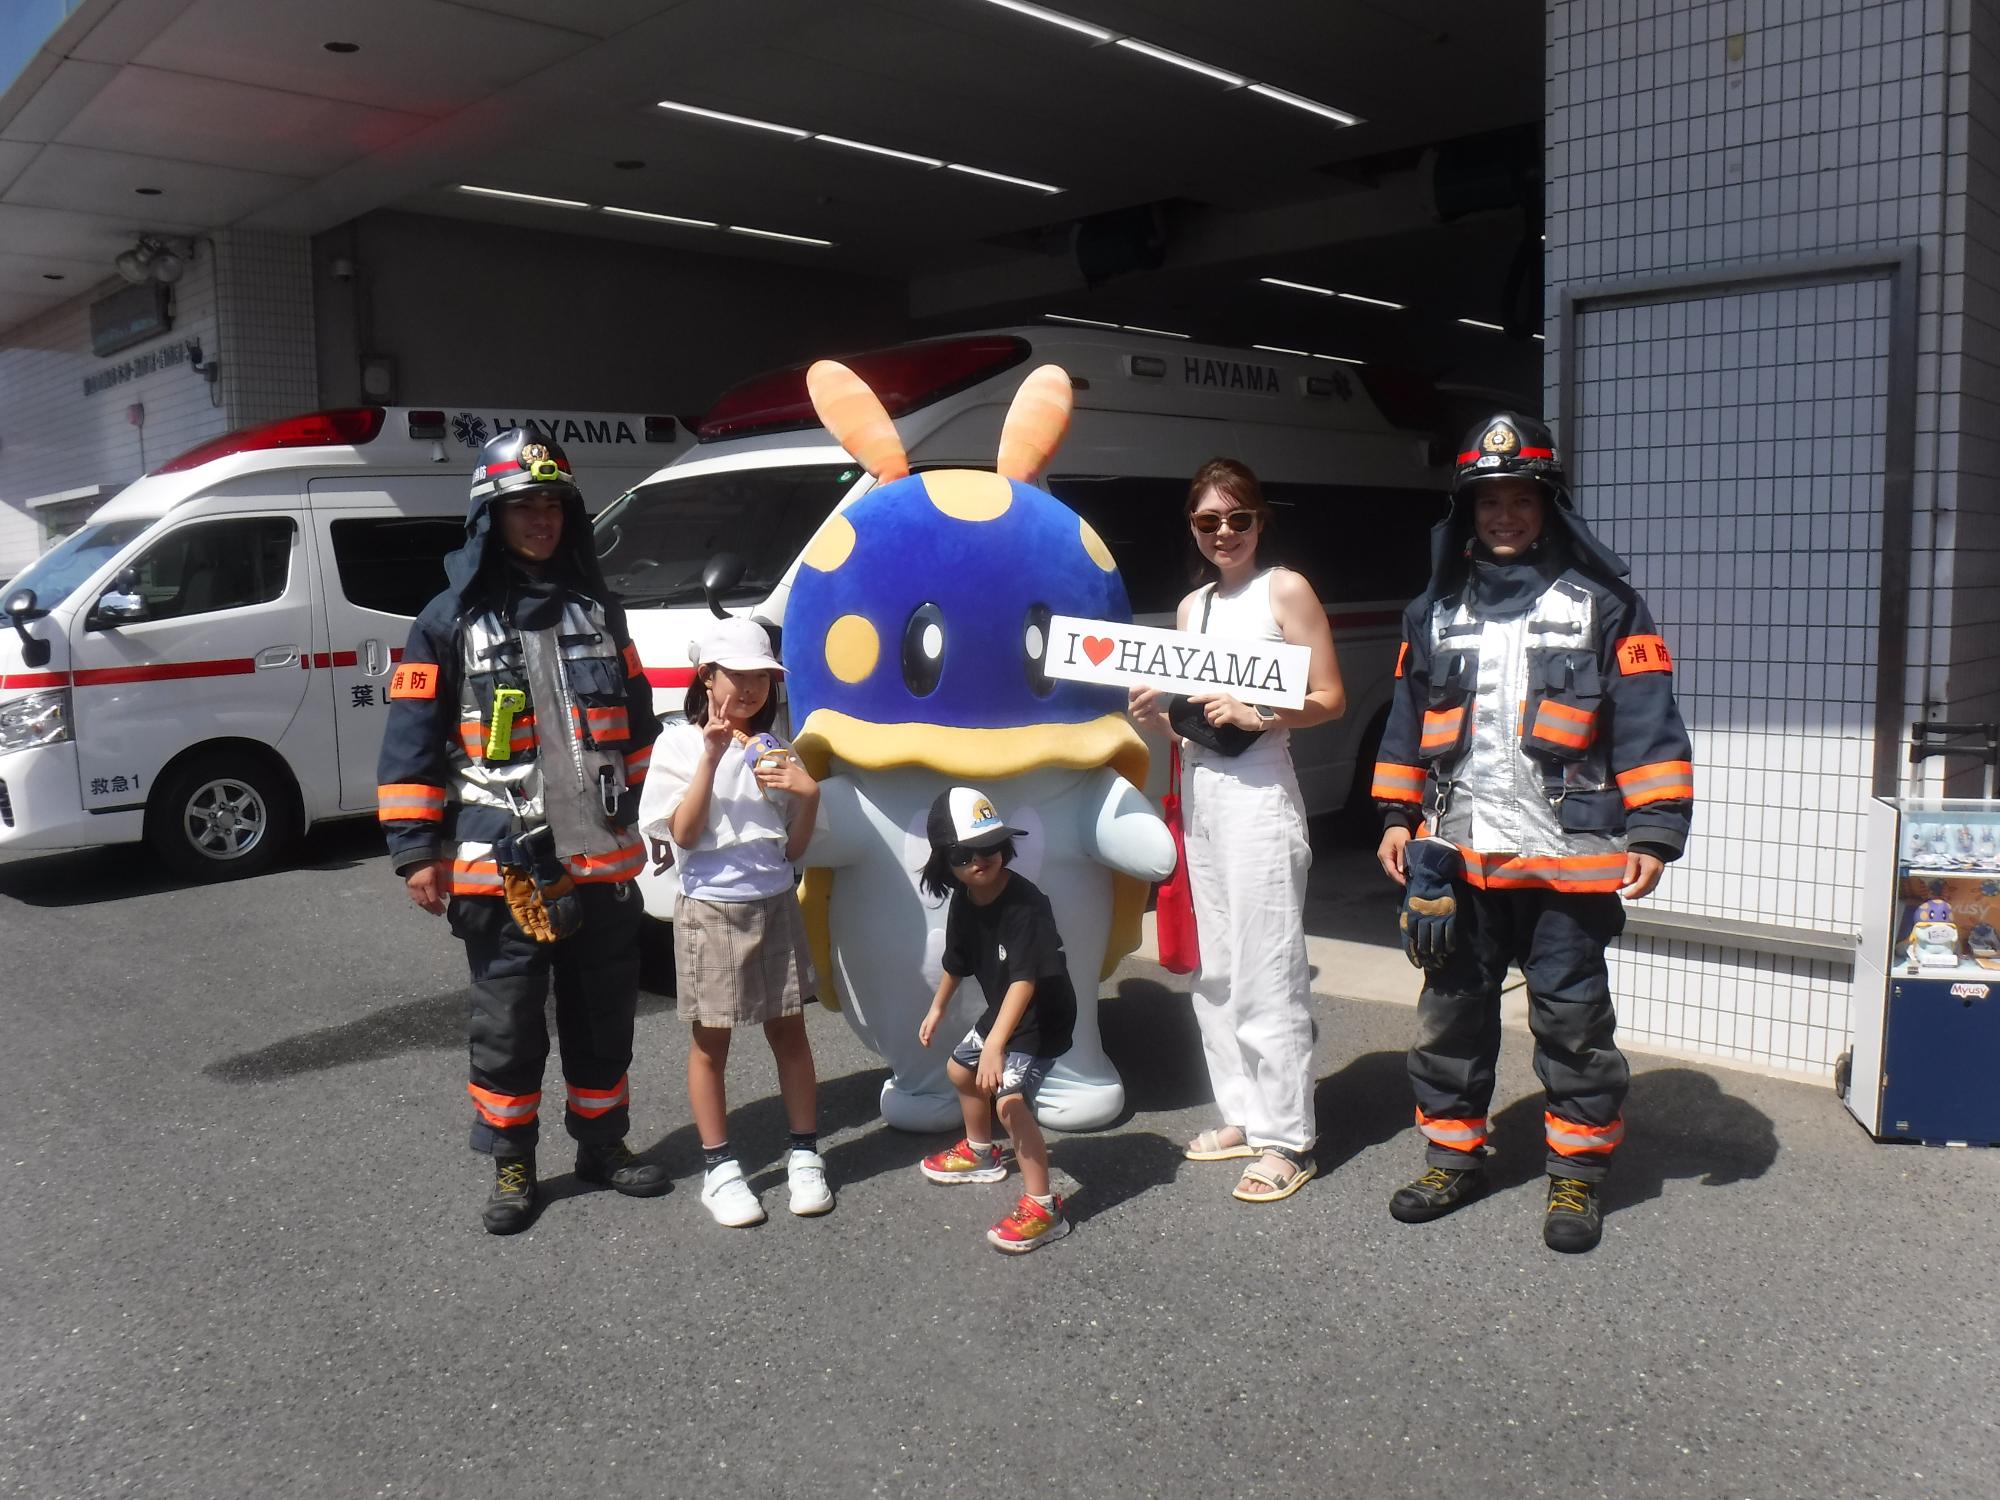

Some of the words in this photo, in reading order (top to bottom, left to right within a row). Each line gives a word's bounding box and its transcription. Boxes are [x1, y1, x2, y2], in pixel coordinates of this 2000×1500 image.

[1184, 356, 1280, 393] HAYAMA
[1063, 632, 1081, 665] I
[1114, 639, 1288, 692] HAYAMA
[1627, 643, 1669, 664] 消防
[393, 671, 428, 690] 消防
[91, 774, 140, 795] 救急1
[1952, 985, 1988, 997] Myusy
